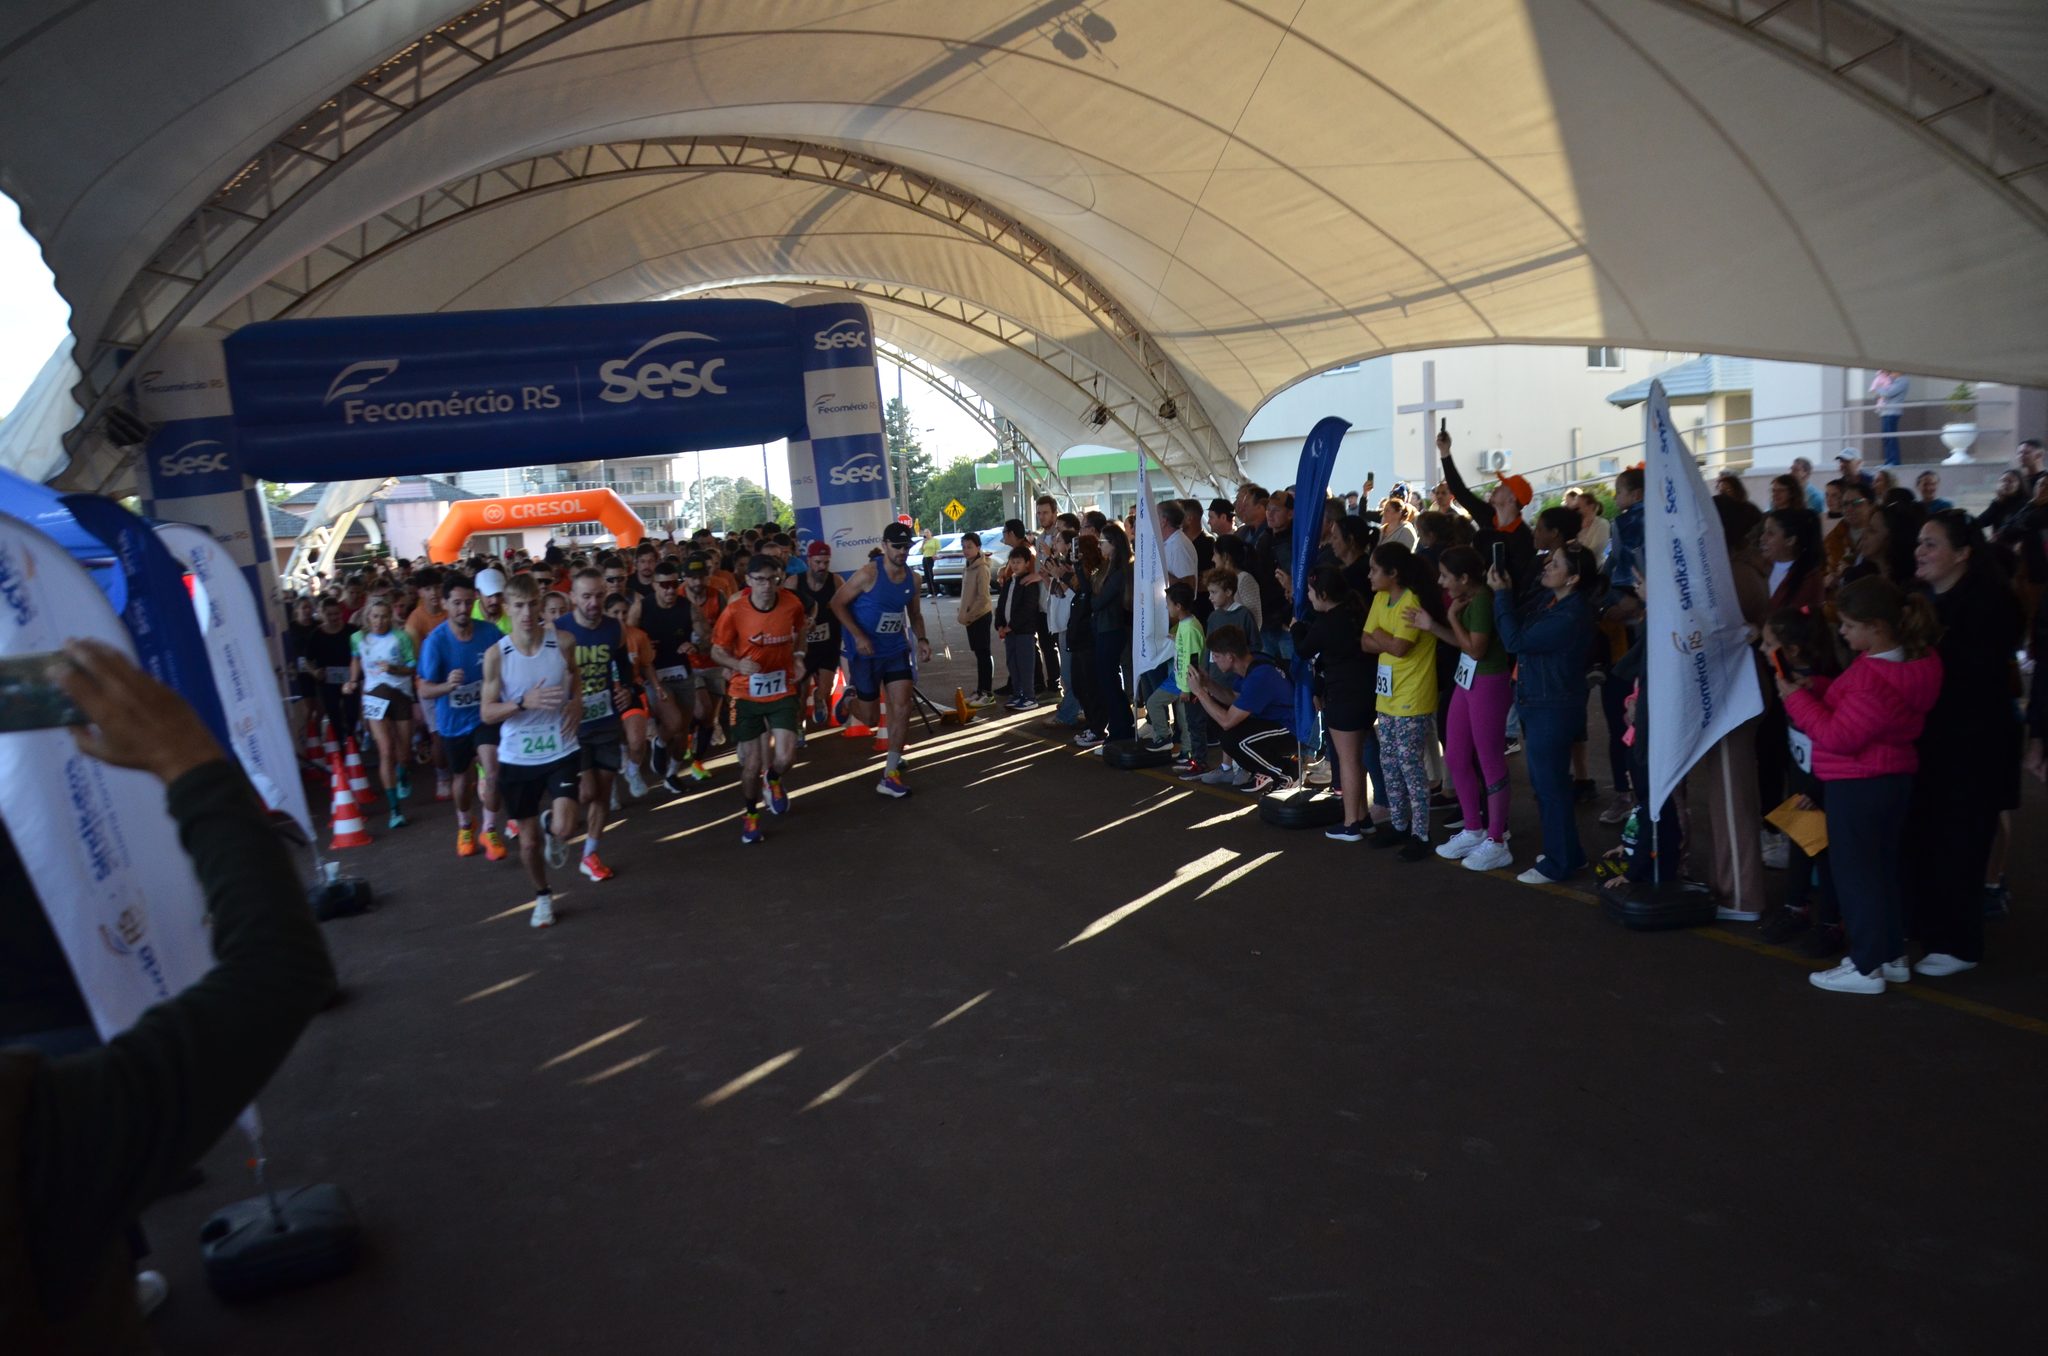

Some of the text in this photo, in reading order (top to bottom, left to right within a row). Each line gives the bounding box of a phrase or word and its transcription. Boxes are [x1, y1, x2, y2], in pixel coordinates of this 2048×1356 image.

[598, 351, 728, 403] Sesc
[343, 384, 561, 425] Fecomércio RS
[817, 402, 869, 414] Fecomércio
[510, 499, 587, 520] CRESOL
[806, 630, 827, 641] 627
[754, 679, 781, 695] 717
[522, 734, 556, 753] 244
